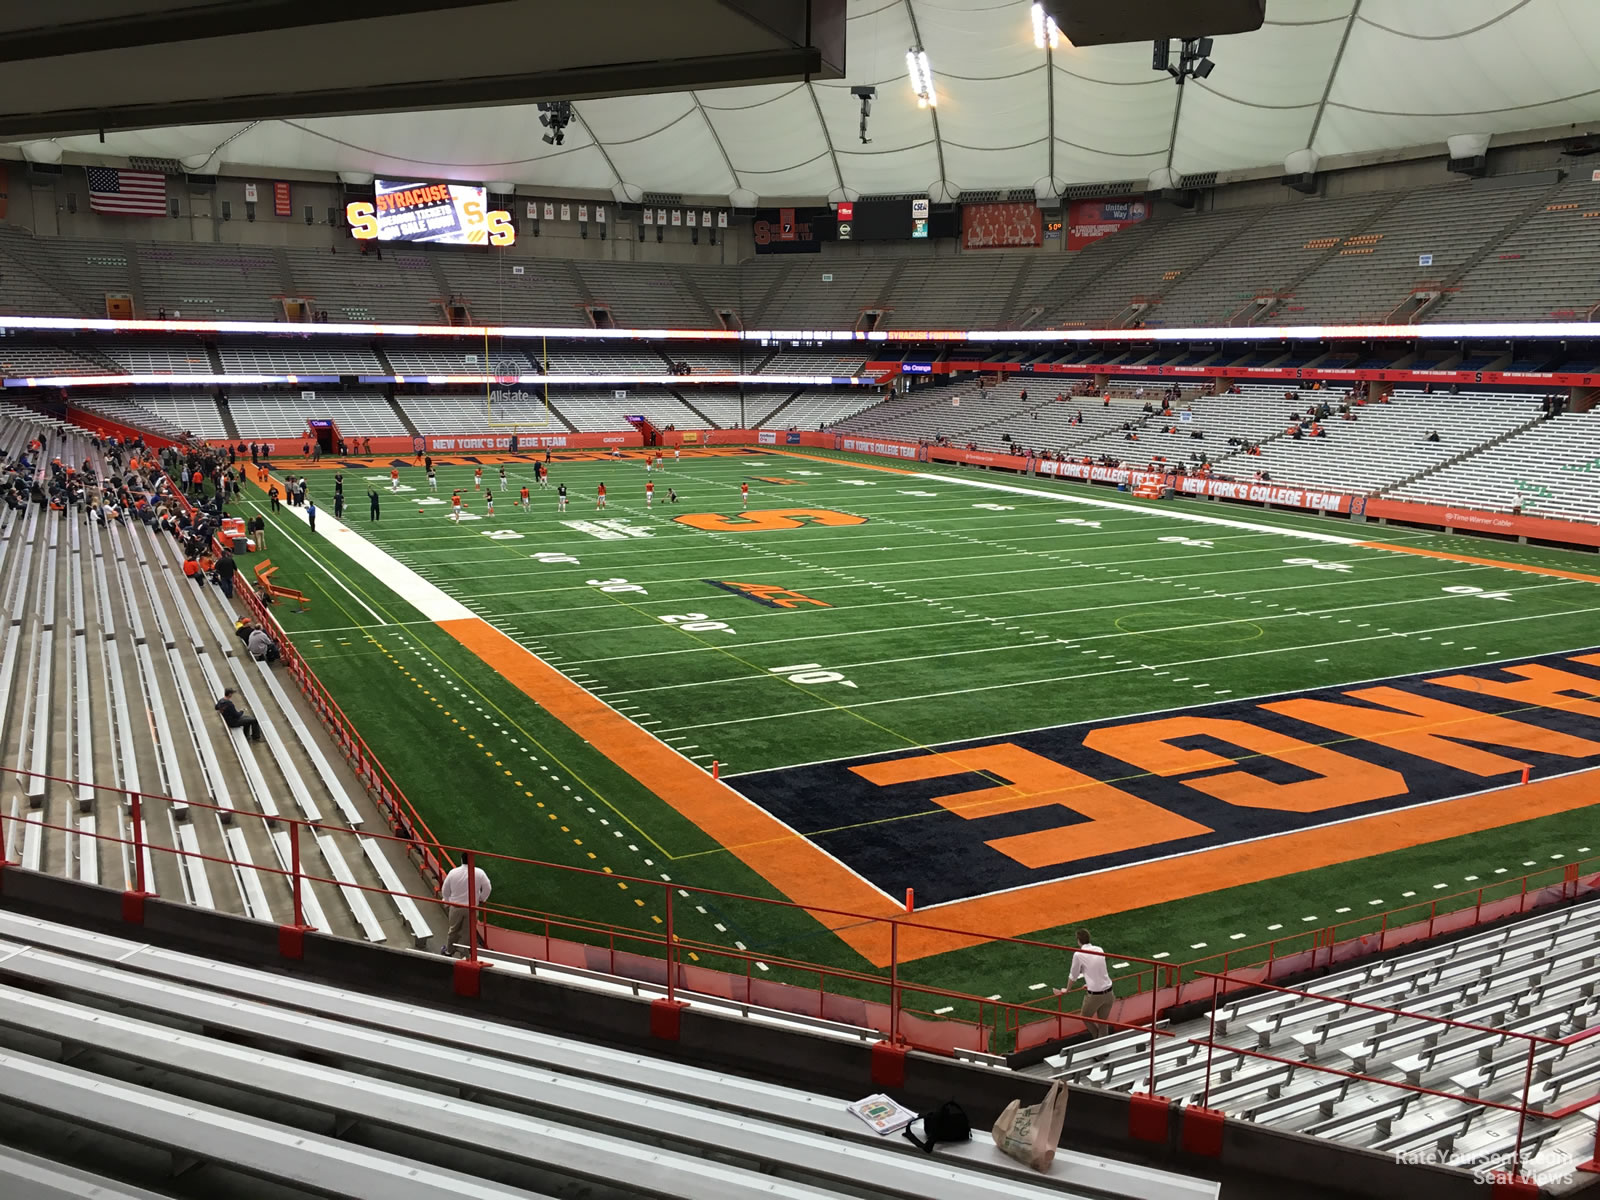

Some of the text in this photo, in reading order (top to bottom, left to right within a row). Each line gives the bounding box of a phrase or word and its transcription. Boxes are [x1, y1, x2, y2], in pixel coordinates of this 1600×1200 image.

[376, 185, 450, 211] SYRACUSE
[1105, 203, 1128, 211] United
[347, 202, 378, 239] S
[463, 202, 484, 224] S
[1113, 211, 1127, 220] Way
[487, 211, 515, 246] S
[755, 221, 771, 244] S
[785, 224, 795, 232] 7
[1296, 369, 1302, 378] S
[1475, 372, 1482, 383] S
[490, 390, 529, 403] Allstate
[432, 436, 567, 449] NEW YORK'S COEGE TEAM
[855, 441, 875, 453] YORK'S
[875, 443, 899, 456] COLLEGE
[900, 446, 916, 458] TEAM
[1040, 460, 1058, 474] NEW
[1060, 463, 1090, 477] YORK'S
[1091, 466, 1131, 483] COLLEGE
[1182, 477, 1342, 511] NEW YORK'S COLLEGE TEAM
[1351, 496, 1364, 514] S
[1453, 513, 1512, 527] Time Warner Cable
[585, 578, 643, 593] 30
[720, 580, 834, 608] ACC
[657, 613, 729, 632] 20
[768, 663, 845, 684] 10
[848, 652, 1600, 869] ANGE
[1486, 1129, 1501, 1138] G
